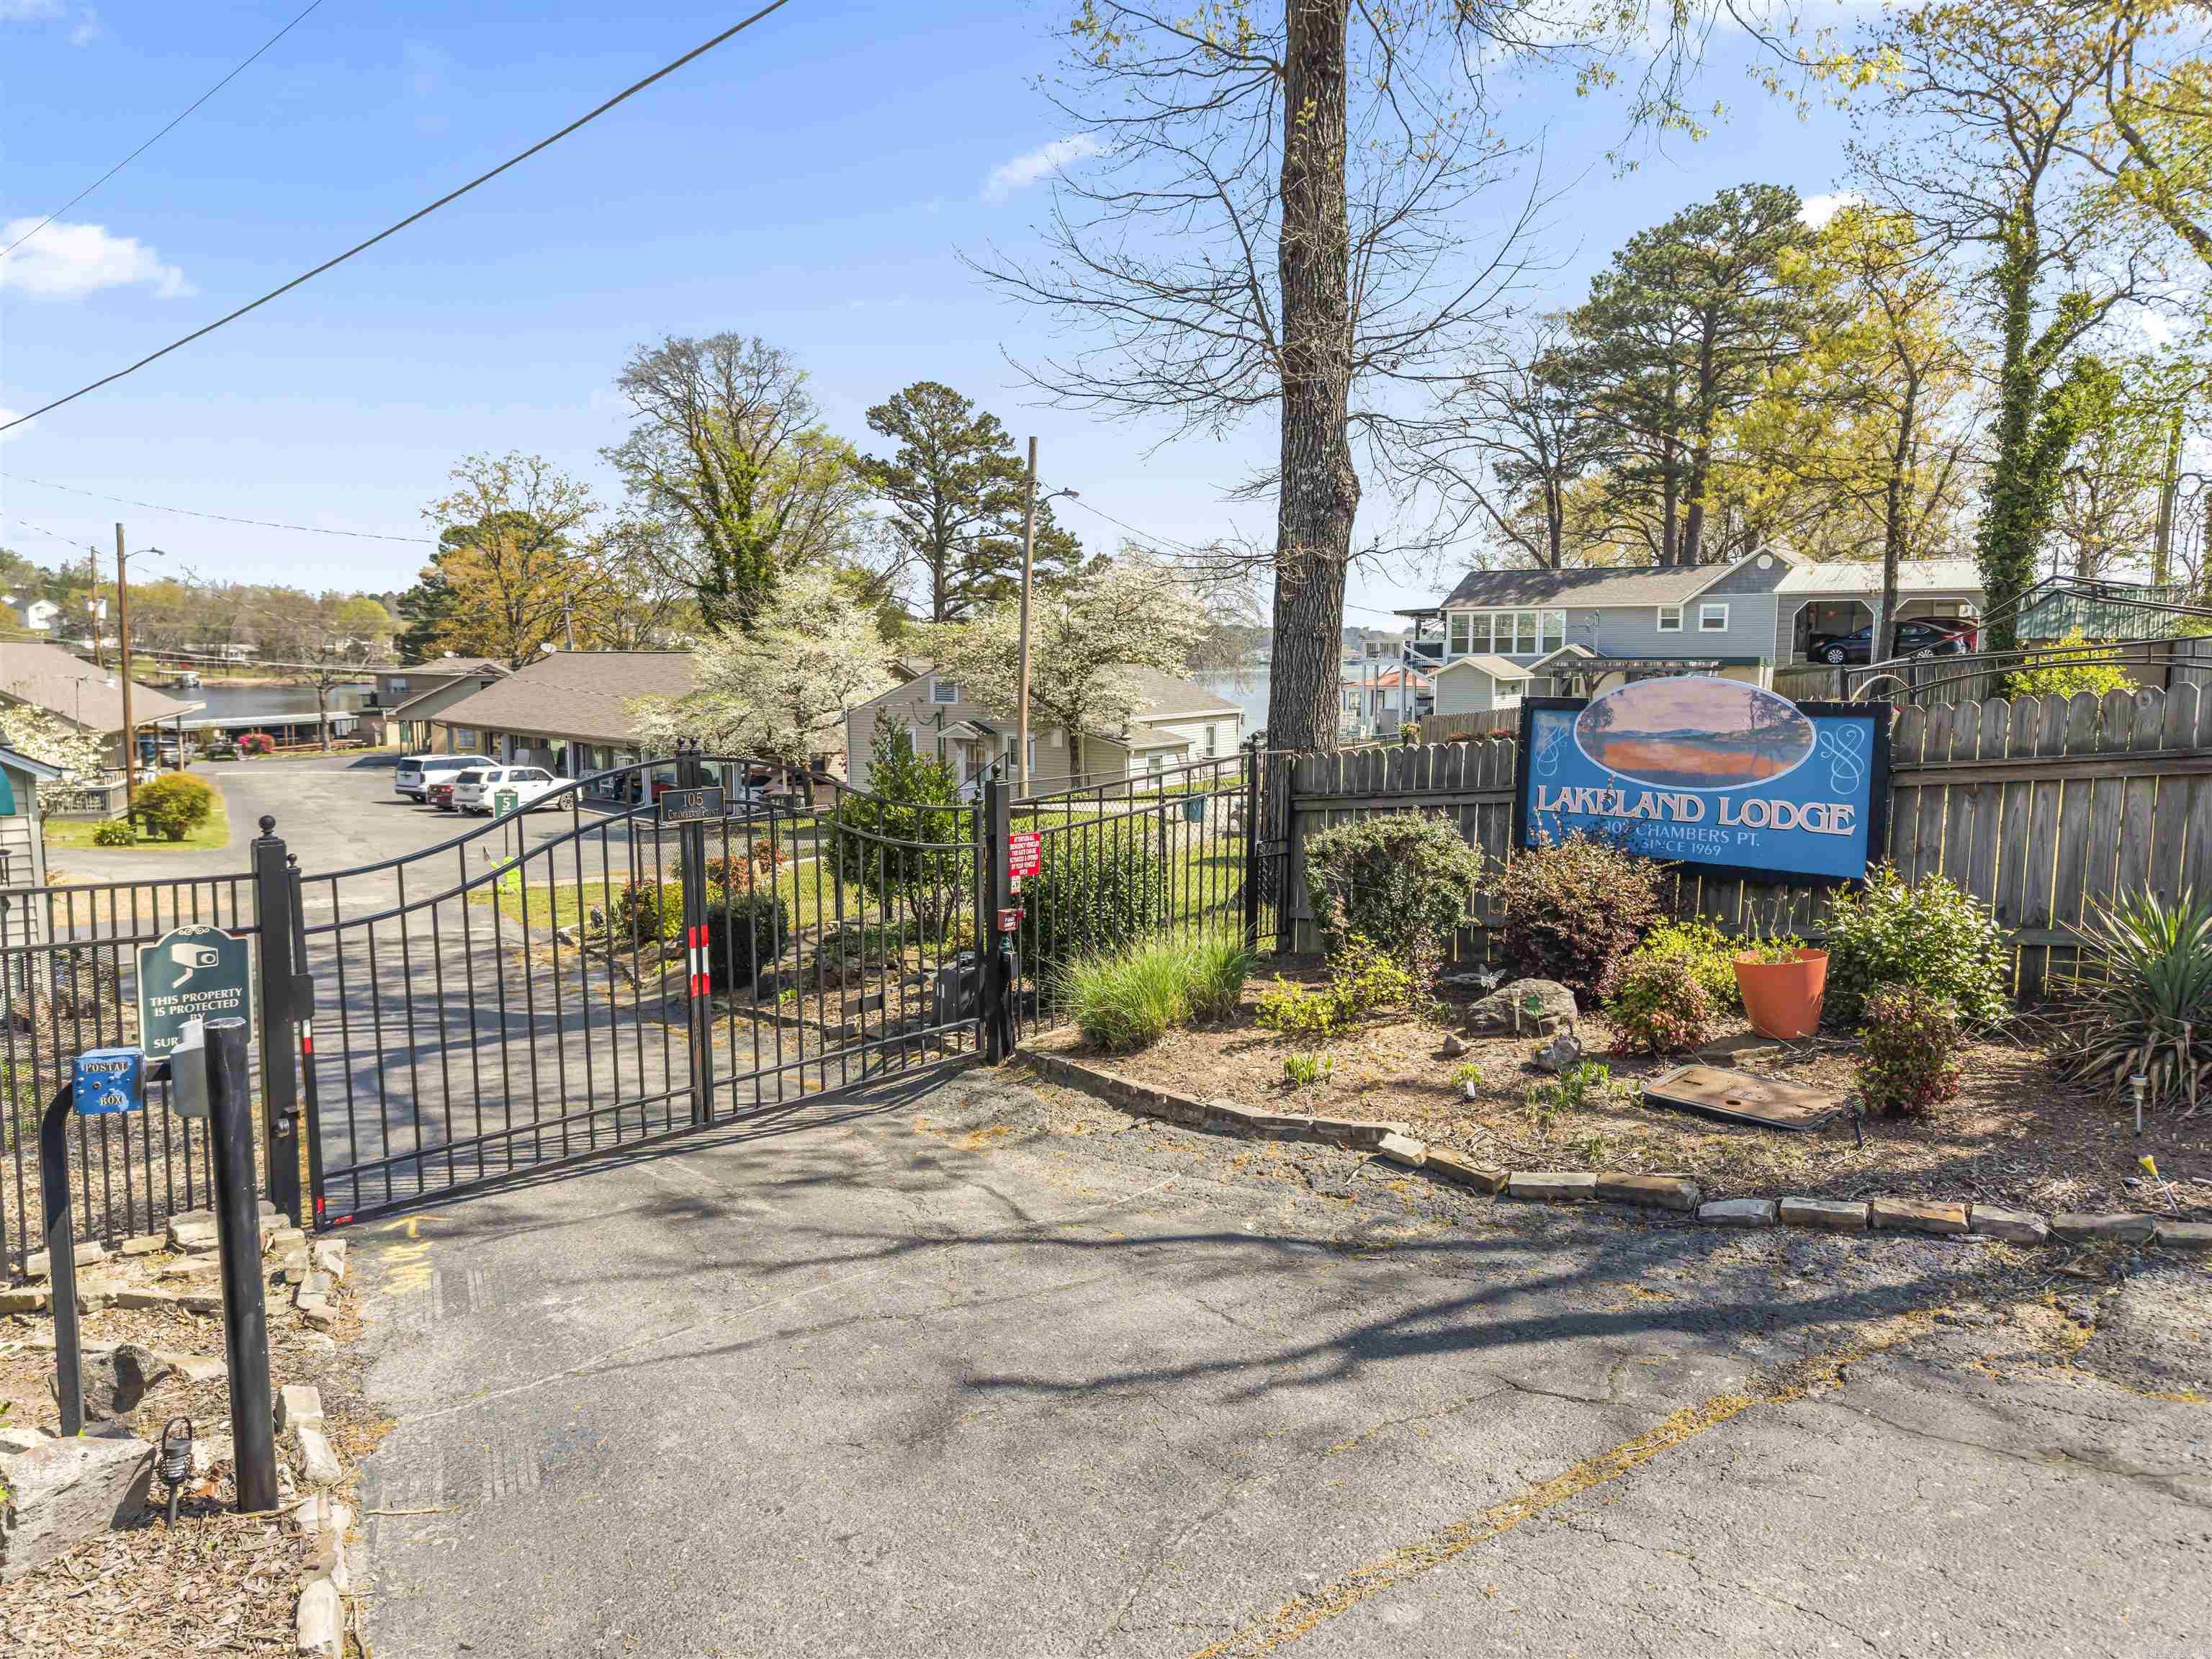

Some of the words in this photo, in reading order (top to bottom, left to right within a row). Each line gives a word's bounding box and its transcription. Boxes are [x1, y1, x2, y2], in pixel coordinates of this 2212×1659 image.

[503, 797, 511, 808] 5
[683, 792, 703, 807] 105
[1537, 785, 1705, 823] LAKELAND
[1717, 796, 1856, 836] LODGE
[1635, 823, 1730, 844] CHAMBERS
[1737, 832, 1761, 847] PT.
[1641, 838, 1686, 853] SINCE
[1691, 843, 1722, 855] 1969
[150, 994, 179, 1007] THIS
[183, 988, 243, 1003] PROPERTY
[154, 1007, 166, 1017] IS
[170, 999, 239, 1015] PROTECTED
[85, 1062, 127, 1072] POSTAL
[99, 1095, 122, 1107] BOX
